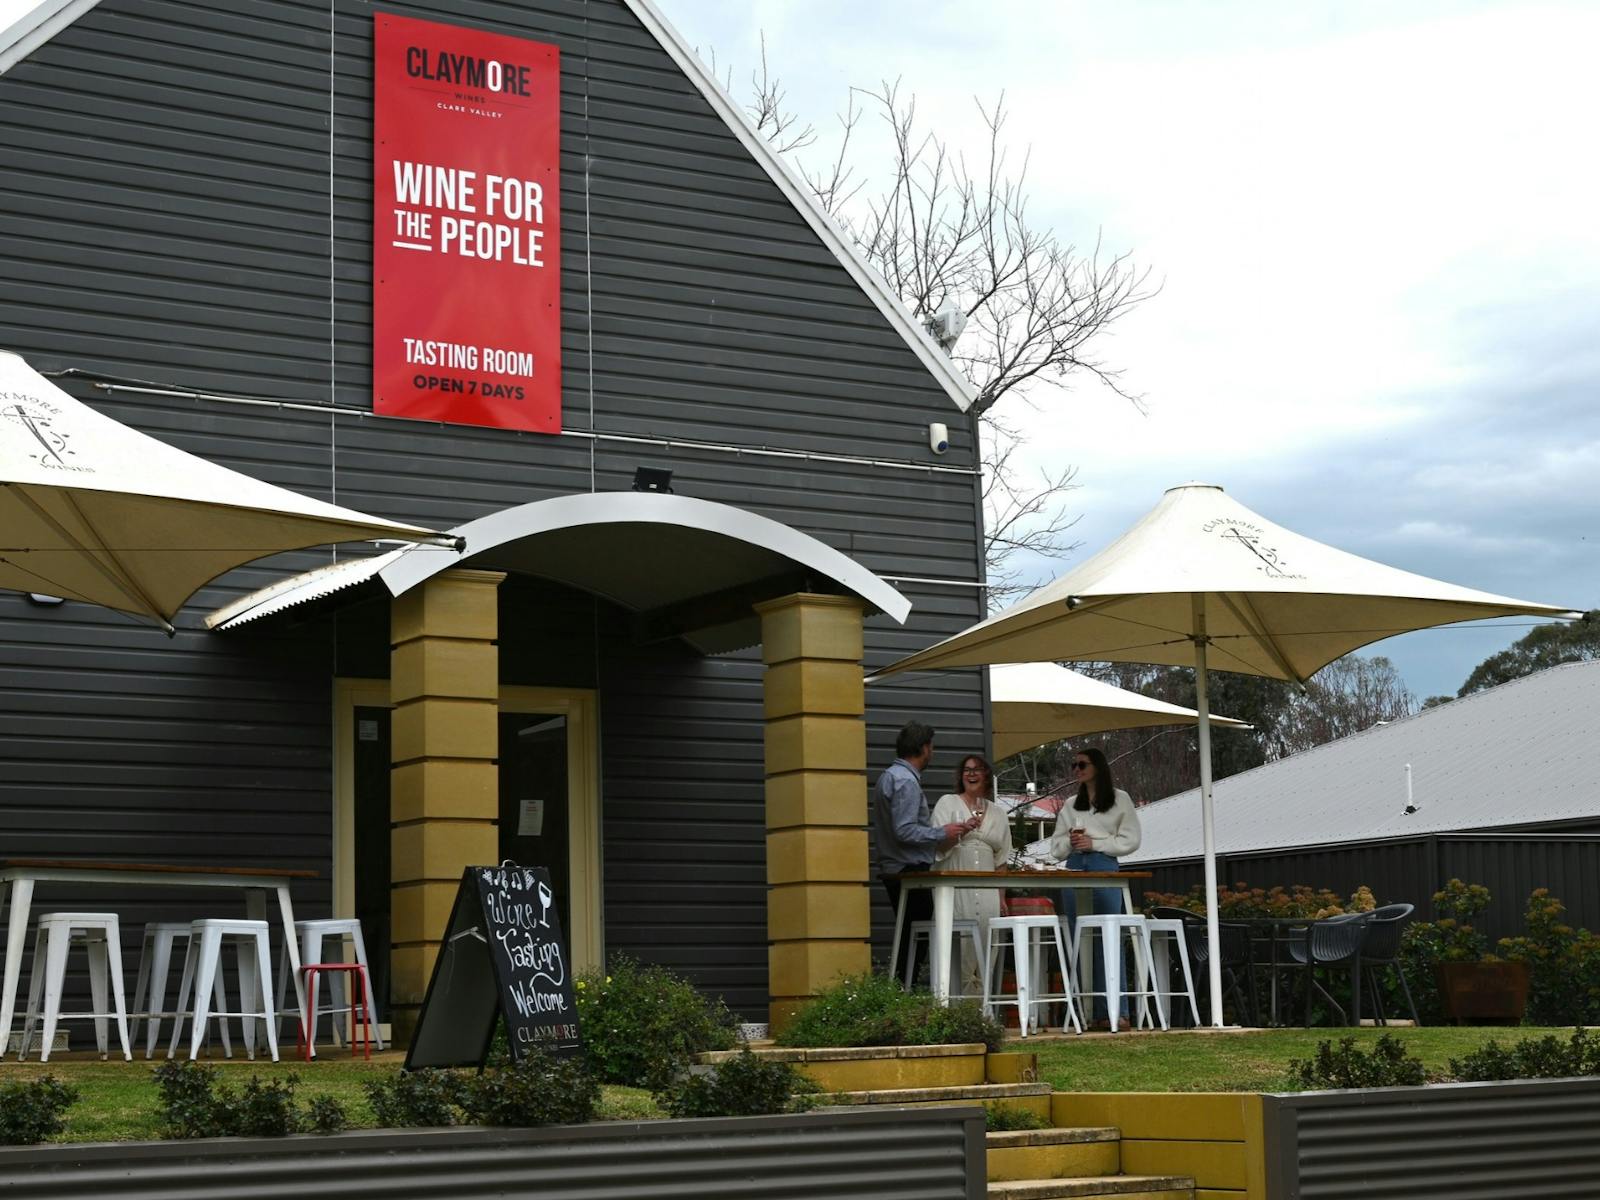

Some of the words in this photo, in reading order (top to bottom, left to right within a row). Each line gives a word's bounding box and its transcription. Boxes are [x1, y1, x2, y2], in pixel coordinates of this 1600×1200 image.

[406, 46, 531, 97] CLAYMORE
[436, 102, 466, 113] CLARE
[469, 107, 503, 119] VALLEY
[455, 92, 486, 104] WINES
[393, 160, 476, 213] WINE
[486, 174, 543, 224] FOR
[394, 209, 432, 239] THE
[441, 216, 544, 267] PEOPLE
[403, 338, 478, 370] TASTING
[483, 348, 533, 377] ROOM
[0, 392, 62, 415] YMORE
[413, 374, 464, 394] OPEN
[468, 381, 478, 394] 7
[481, 383, 525, 400] DAYS
[487, 890, 537, 930] Wine
[496, 928, 565, 986] Tasting
[509, 981, 568, 1018] Welcome
[517, 1024, 579, 1043] CLAYMORE
